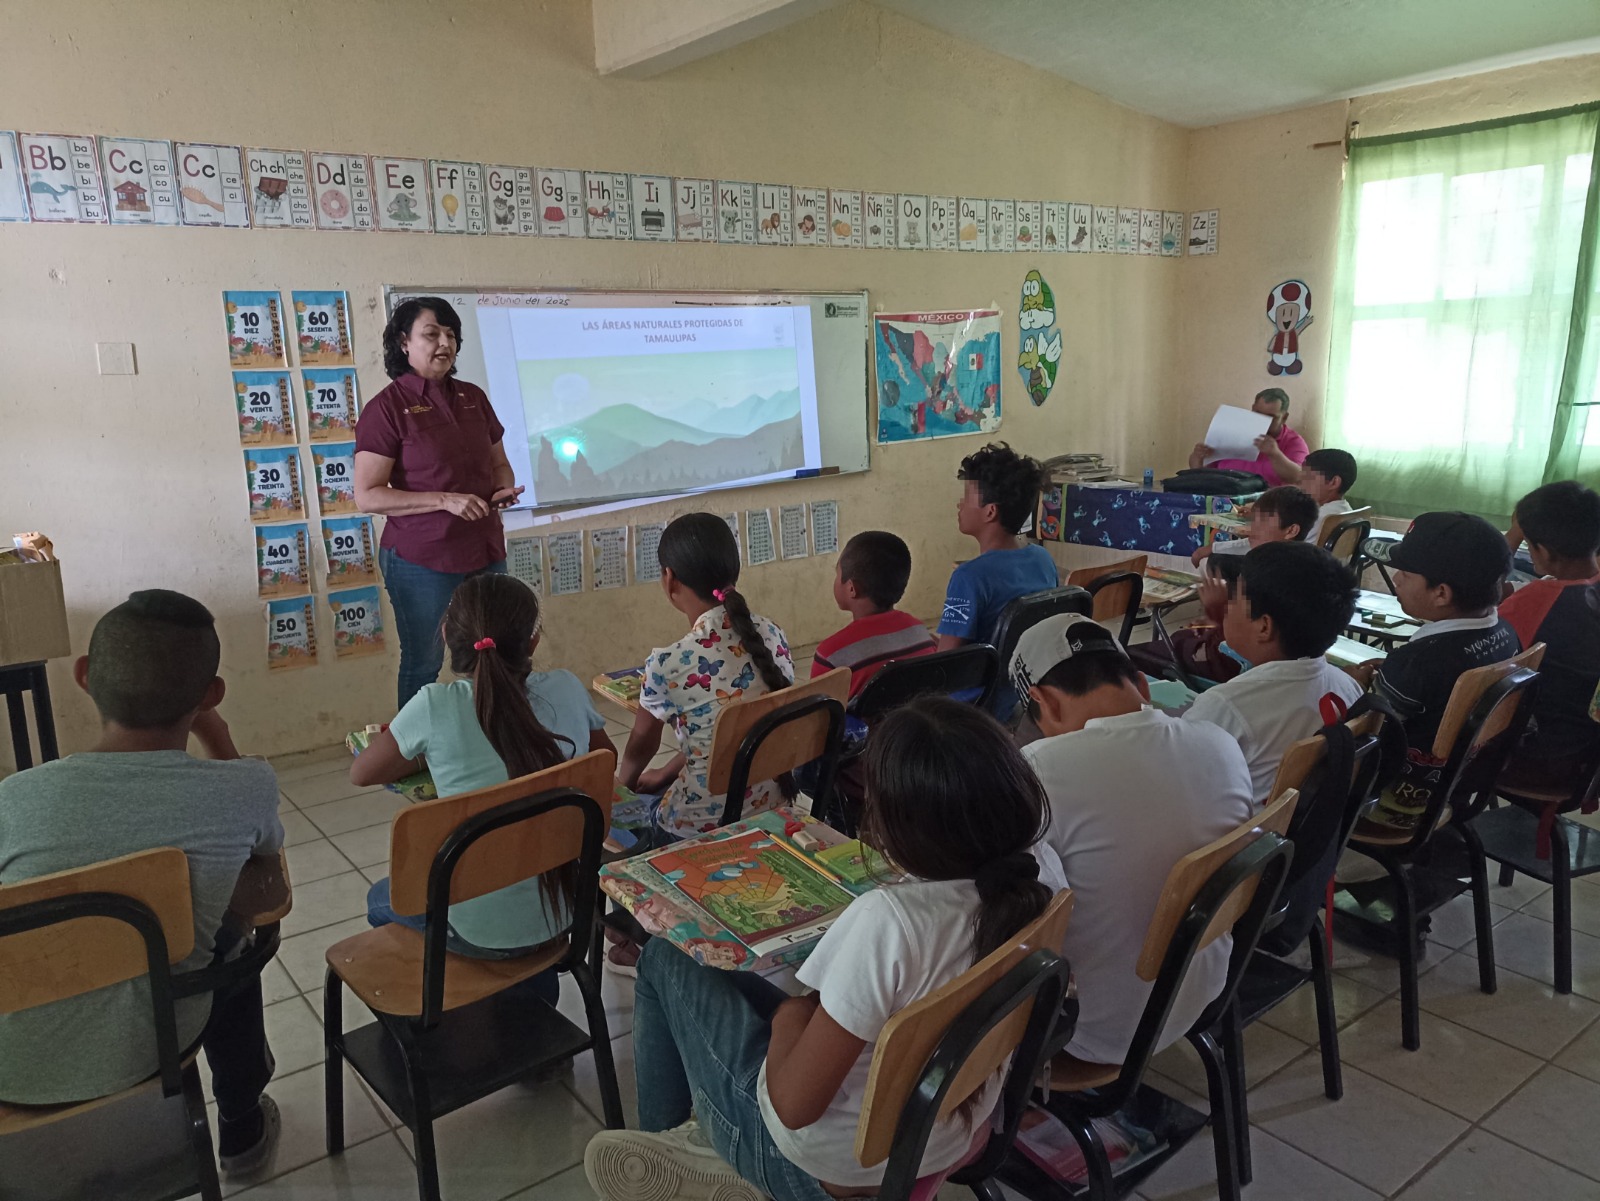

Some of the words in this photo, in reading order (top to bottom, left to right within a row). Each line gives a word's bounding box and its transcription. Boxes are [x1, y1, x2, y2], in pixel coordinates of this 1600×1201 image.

[74, 142, 88, 152] ba
[29, 145, 66, 170] Bb
[77, 158, 90, 169] be
[109, 149, 144, 174] Cc
[287, 157, 302, 165] cha
[153, 164, 166, 172] ca
[184, 154, 216, 178] Cc
[352, 161, 362, 170] da
[467, 168, 476, 176] fa
[81, 176, 91, 185] bi
[290, 172, 304, 180] che
[316, 162, 346, 186] Dd
[354, 176, 364, 184] de
[386, 164, 415, 189] Ee
[436, 168, 458, 189] Ff
[468, 181, 476, 190] fe
[489, 171, 514, 197] Gg
[542, 177, 564, 202] Gg
[589, 180, 610, 200] Hh
[83, 192, 96, 202] bo
[158, 194, 170, 202] cu
[357, 190, 364, 198] di
[644, 182, 658, 203] Ii
[681, 186, 696, 210] Jj
[720, 189, 738, 207] Kk
[358, 204, 368, 212] do
[762, 192, 774, 210] Ll
[796, 194, 816, 208] Mm
[834, 197, 850, 214] Nn
[867, 196, 882, 218] Ññ
[86, 208, 99, 218] bu
[471, 208, 479, 216] fo
[904, 200, 921, 218] Oo
[932, 202, 946, 221] Pp
[962, 202, 976, 220] Qq
[992, 206, 1004, 221] Rr
[1018, 208, 1030, 222] Ss
[1046, 208, 1056, 222] Tt
[1074, 208, 1086, 224] Uu
[295, 216, 309, 224] chu
[359, 218, 369, 226] du
[1096, 210, 1106, 224] Vv
[1119, 214, 1131, 224] Ww
[1142, 214, 1152, 228] Xx
[1164, 216, 1174, 232] Yy
[1192, 216, 1206, 230] Zz
[472, 222, 480, 230] fu
[524, 224, 532, 232] gu
[478, 294, 490, 304] de
[546, 296, 570, 306] 2025
[240, 312, 260, 327] 10
[308, 312, 328, 326] 60
[582, 320, 600, 331] LAS
[602, 318, 632, 330] ÁREAS
[634, 320, 682, 330] NATURALES
[684, 319, 732, 328] PROTEGIDAS
[734, 318, 744, 328] DE
[918, 313, 964, 322] MÉXICO
[644, 334, 696, 344] TAMAULIPAS
[250, 392, 270, 406] 20
[318, 388, 336, 402] 70
[250, 406, 273, 414] VEINTE
[259, 468, 280, 484] 30
[326, 462, 346, 476] 80
[334, 536, 354, 550] 90
[267, 544, 290, 558] 40
[266, 558, 292, 566] CUARENTA
[340, 606, 366, 622] 100
[276, 618, 296, 633] 50
[273, 632, 302, 640] CINCUENTA
